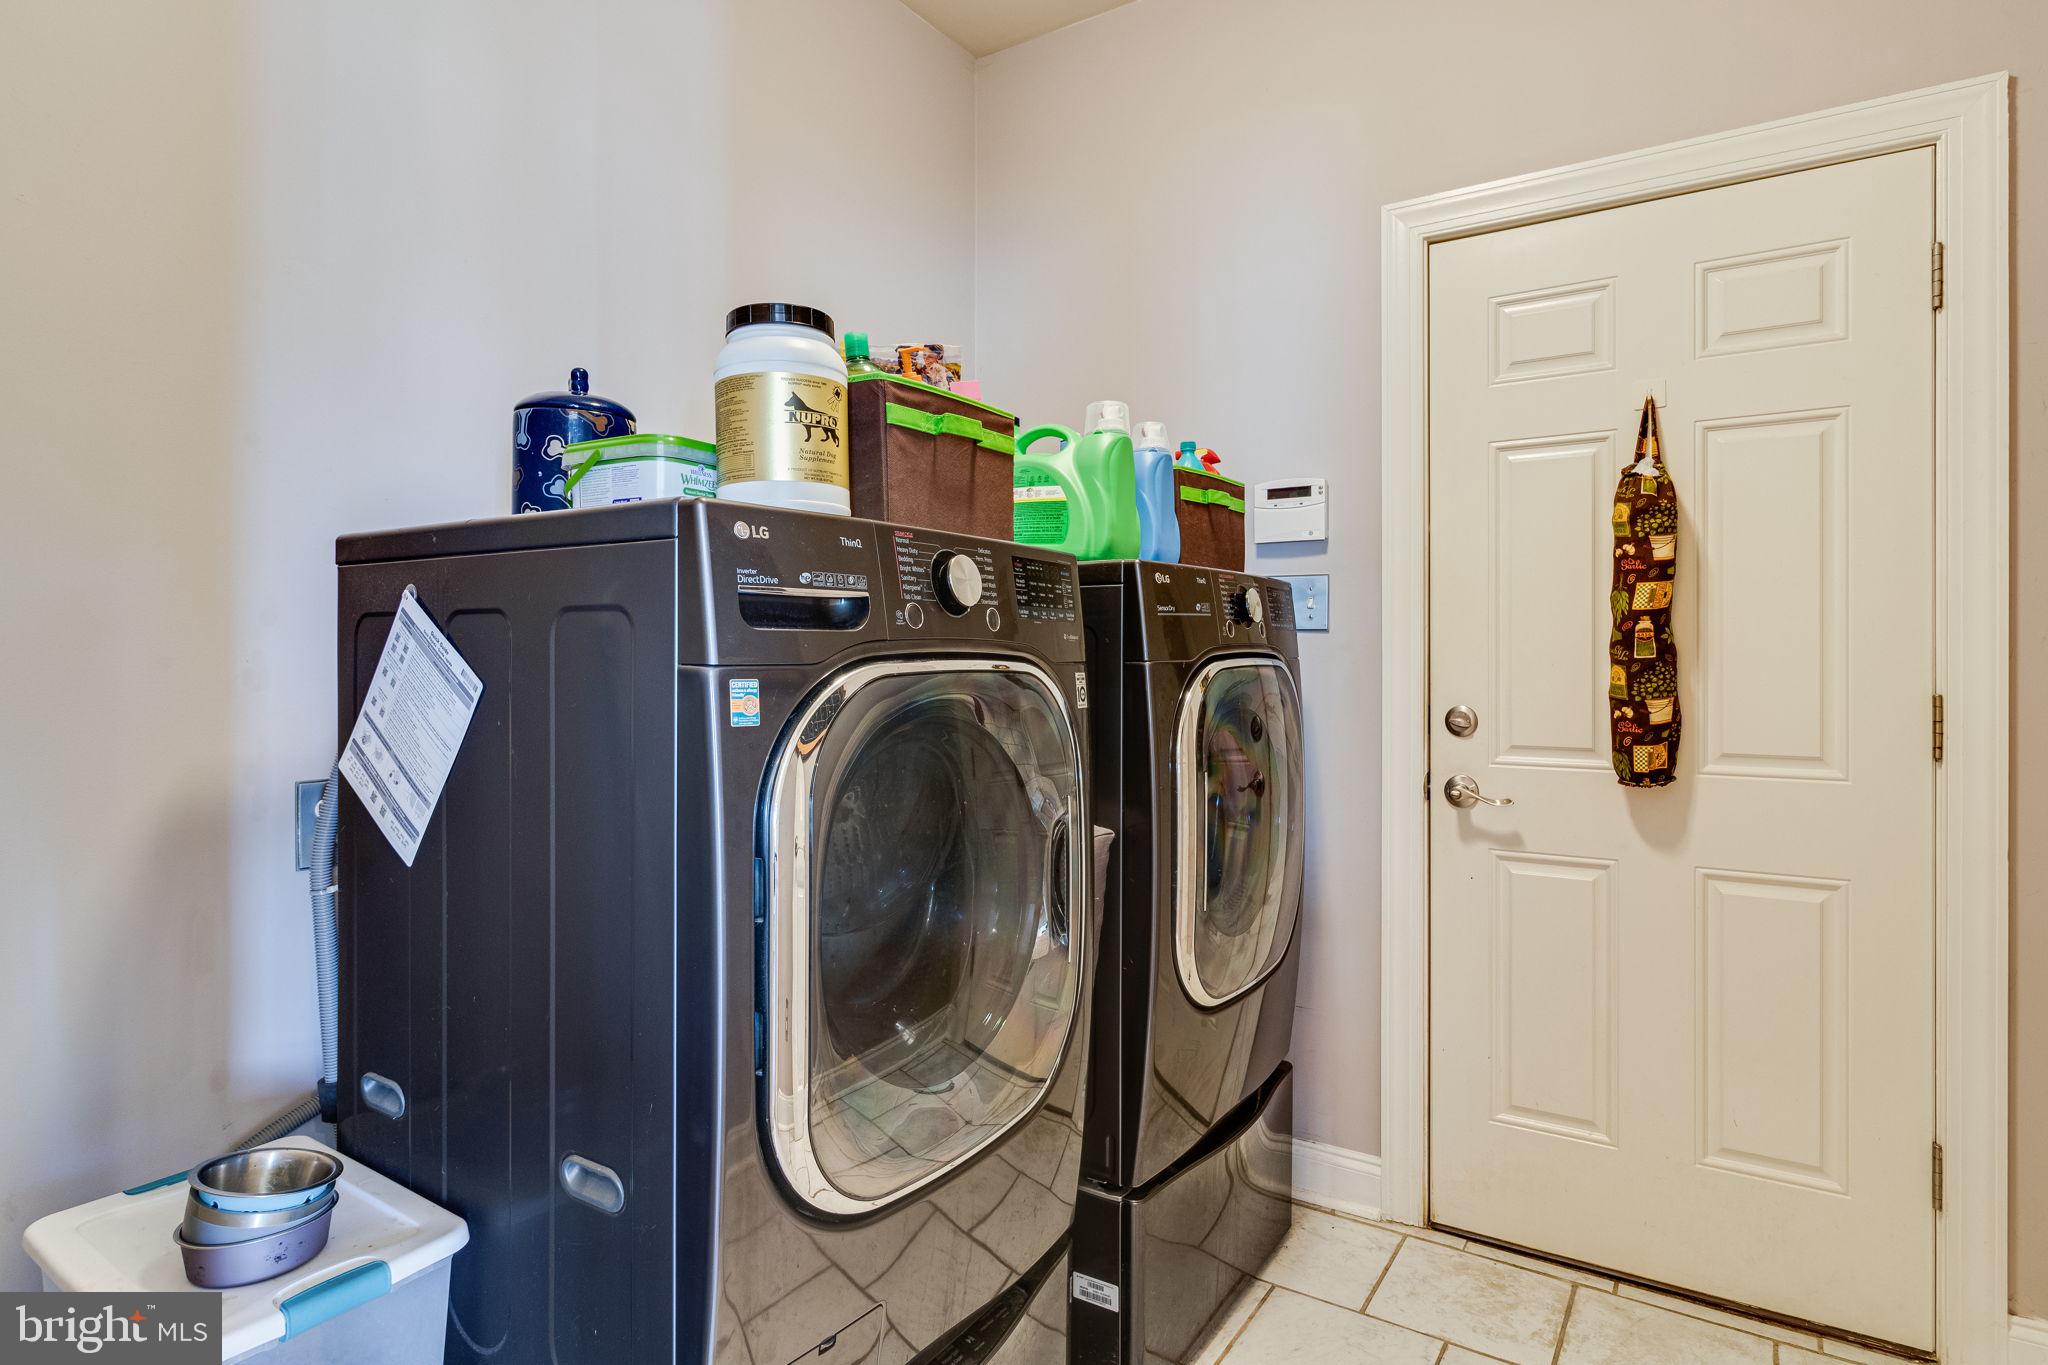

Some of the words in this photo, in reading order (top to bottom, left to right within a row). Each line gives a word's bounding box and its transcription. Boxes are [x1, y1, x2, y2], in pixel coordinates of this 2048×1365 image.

[788, 410, 838, 428] NUPRO
[800, 447, 826, 457] Natural
[827, 452, 837, 460] Dog
[799, 455, 836, 465] Supplement
[681, 472, 718, 489] WHIMZEE
[751, 525, 770, 539] LG
[840, 536, 862, 548] ThinQ
[896, 546, 909, 554] Heavy
[909, 548, 919, 556] Duty
[1621, 558, 1647, 570] Garlic
[736, 567, 758, 575] Inverter
[901, 574, 917, 582] Sanitary
[430, 630, 440, 643] Quick
[1617, 721, 1643, 734] Garlic
